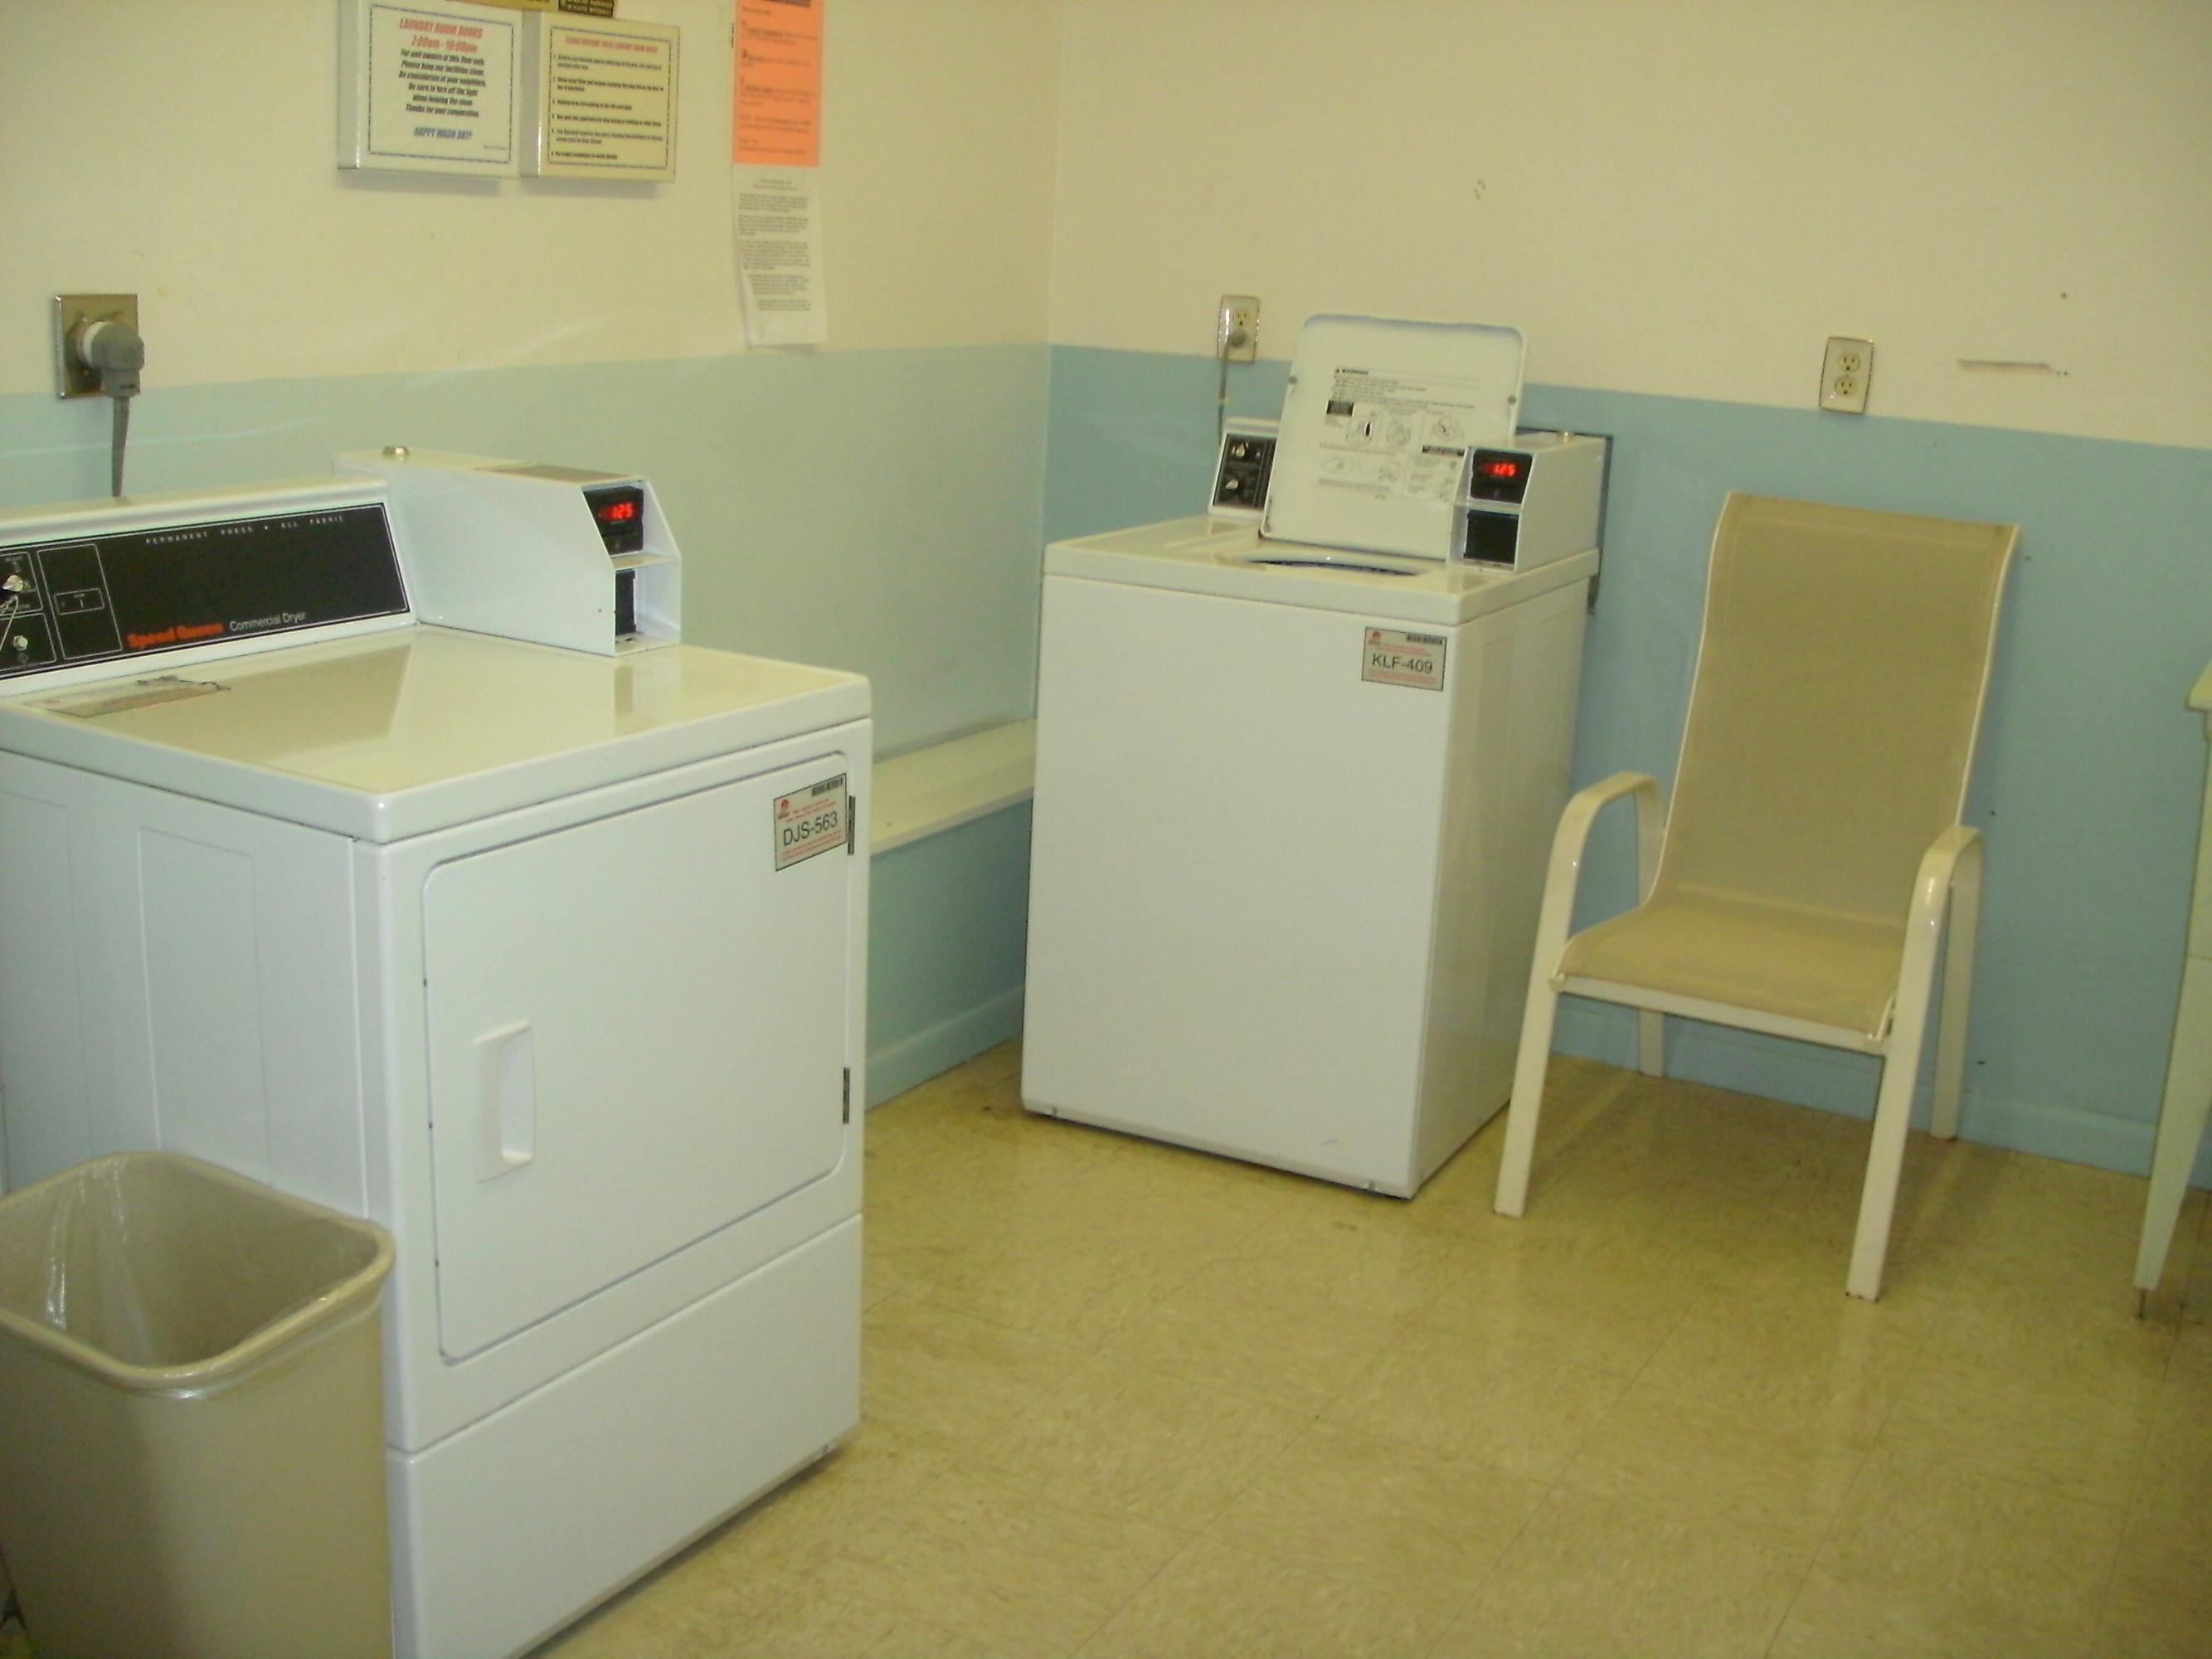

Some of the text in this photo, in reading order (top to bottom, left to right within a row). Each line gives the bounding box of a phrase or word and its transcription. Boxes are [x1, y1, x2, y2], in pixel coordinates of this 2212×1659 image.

[146, 532, 208, 544] PERMANENT
[221, 526, 254, 536] PRESS
[229, 614, 282, 632] Commercial
[282, 611, 306, 625] Dryer
[1372, 653, 1433, 674] KLF-409
[783, 811, 838, 846] DJS-563
